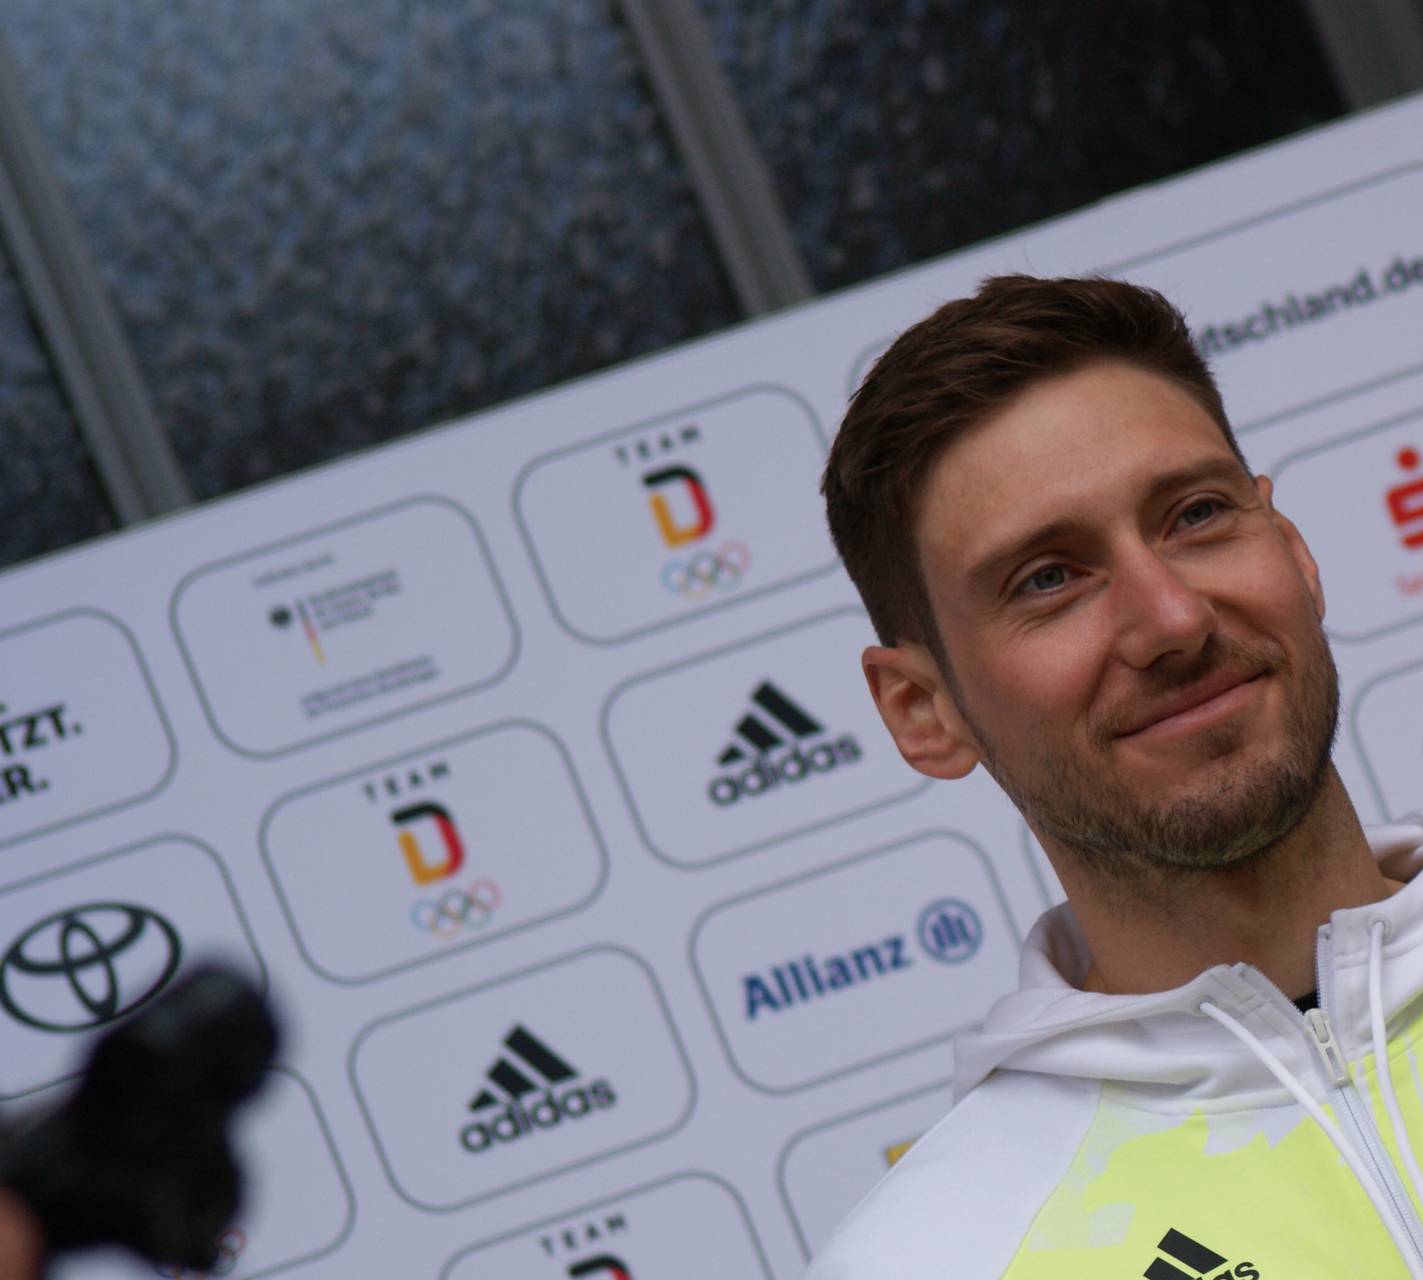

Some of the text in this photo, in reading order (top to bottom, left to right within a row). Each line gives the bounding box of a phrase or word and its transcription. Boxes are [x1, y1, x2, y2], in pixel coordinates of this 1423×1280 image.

[615, 425, 700, 462] TEAM
[362, 761, 449, 801] TEAM
[708, 735, 862, 806] adidas
[740, 935, 912, 1020] Allianz
[458, 1078, 618, 1154] adidas
[541, 1213, 626, 1256] TEAM
